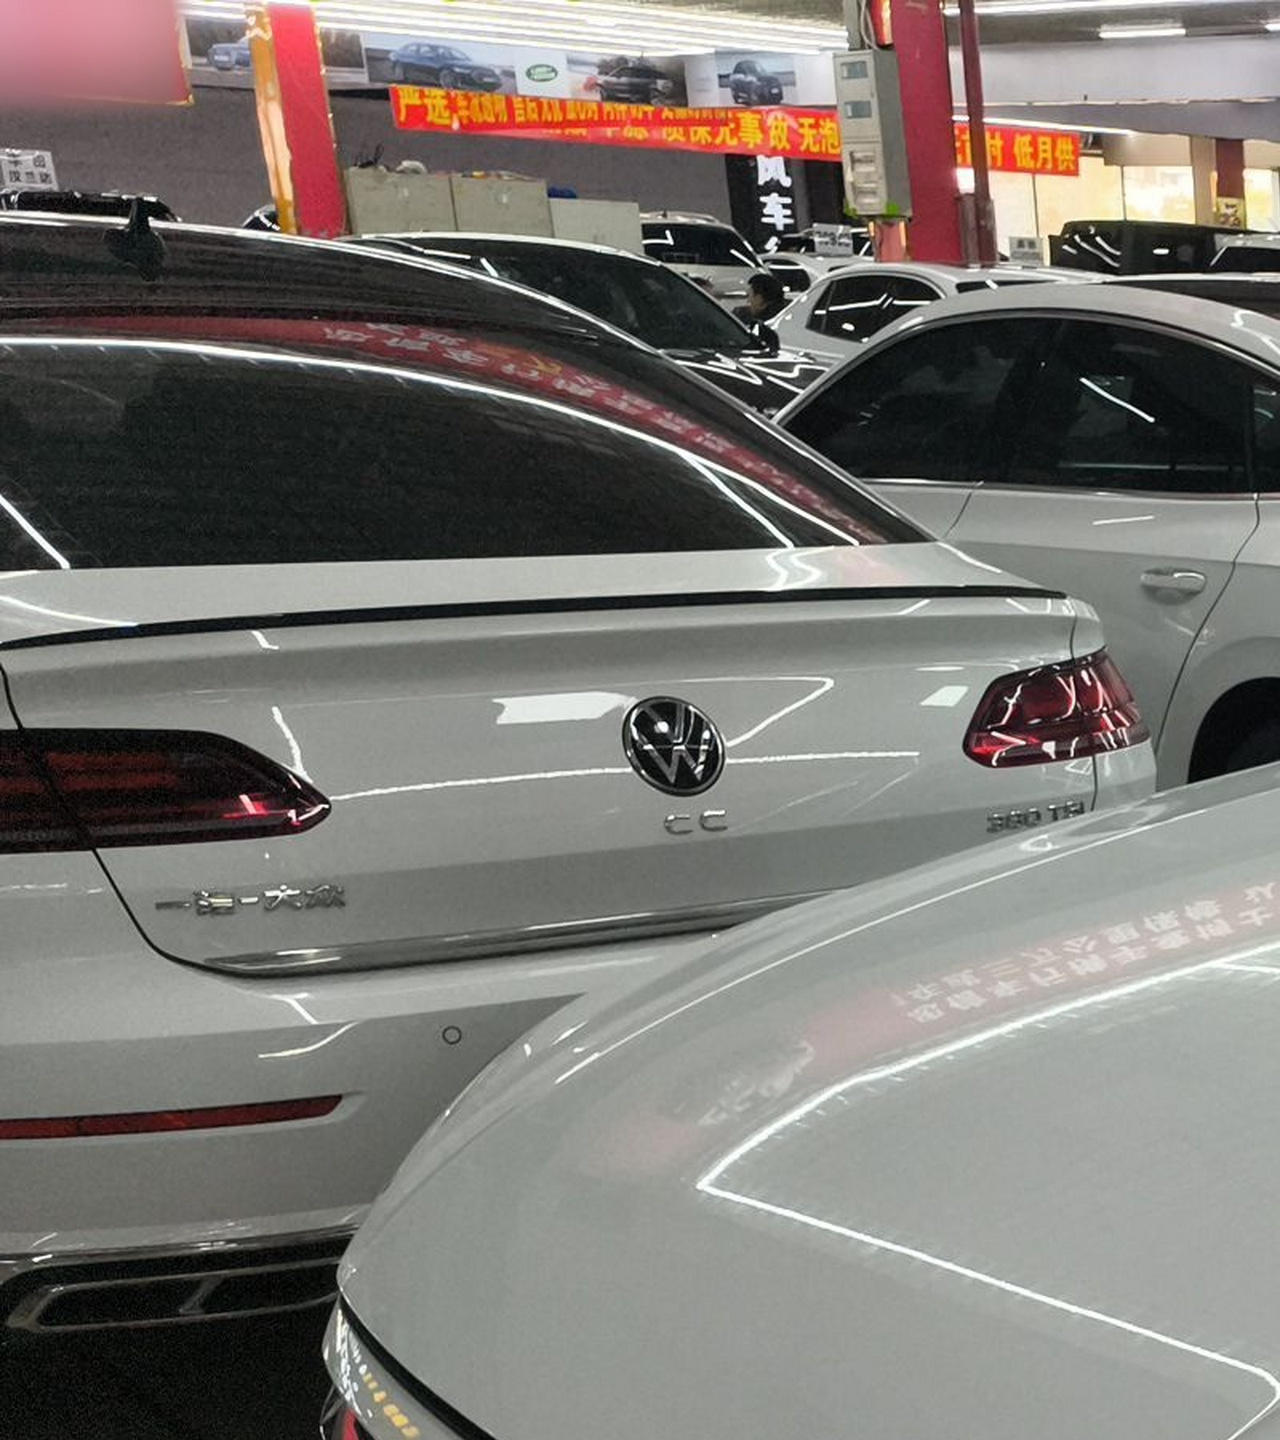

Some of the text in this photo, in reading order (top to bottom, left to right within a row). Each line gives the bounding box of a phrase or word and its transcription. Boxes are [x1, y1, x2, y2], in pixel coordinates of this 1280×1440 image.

[1013, 133, 1076, 171] 低月供
[664, 809, 729, 835] CC
[986, 808, 1042, 833] 380
